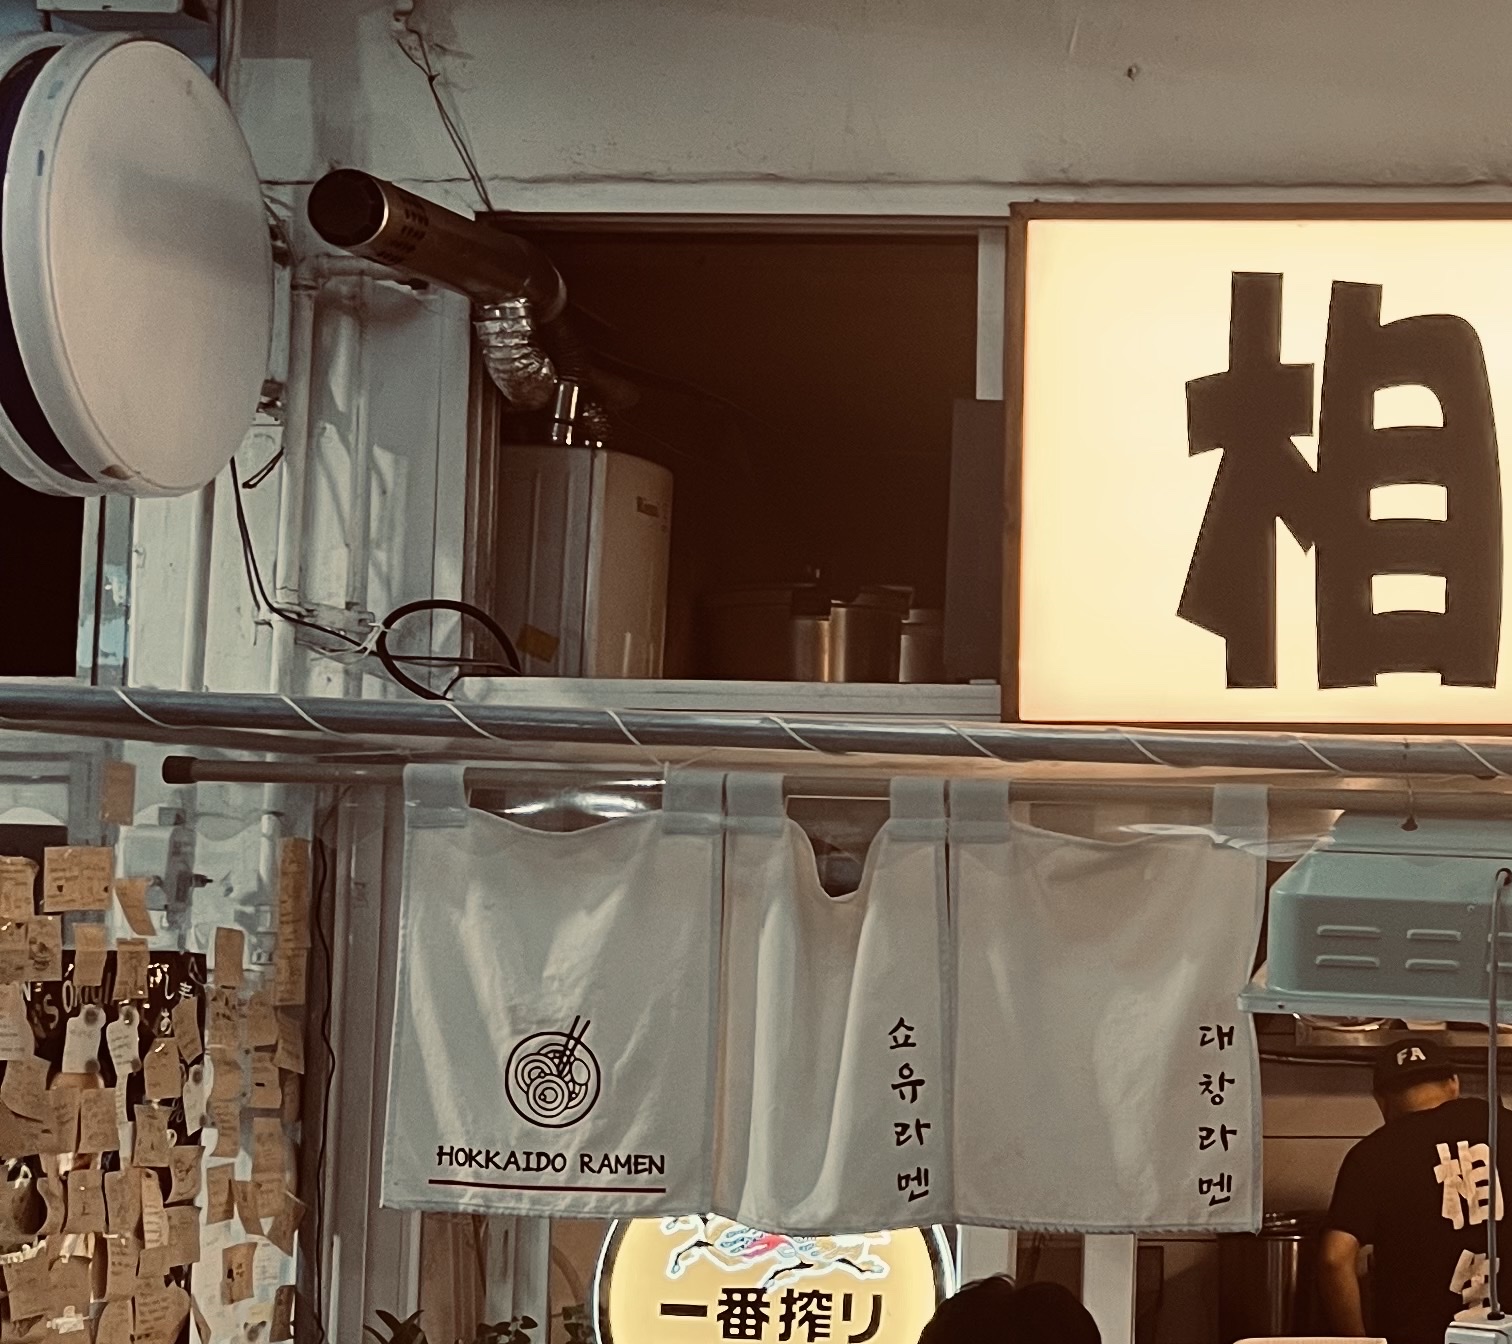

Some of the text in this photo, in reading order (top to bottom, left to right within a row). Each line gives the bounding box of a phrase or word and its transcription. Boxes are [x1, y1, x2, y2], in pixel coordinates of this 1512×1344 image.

[436, 1145, 665, 1176] HOKKAIDO RAMEN
[889, 1017, 931, 1202] 쇼유라멘
[1197, 1023, 1238, 1207] 대창라멘
[660, 1287, 882, 1344] 一番搾り
